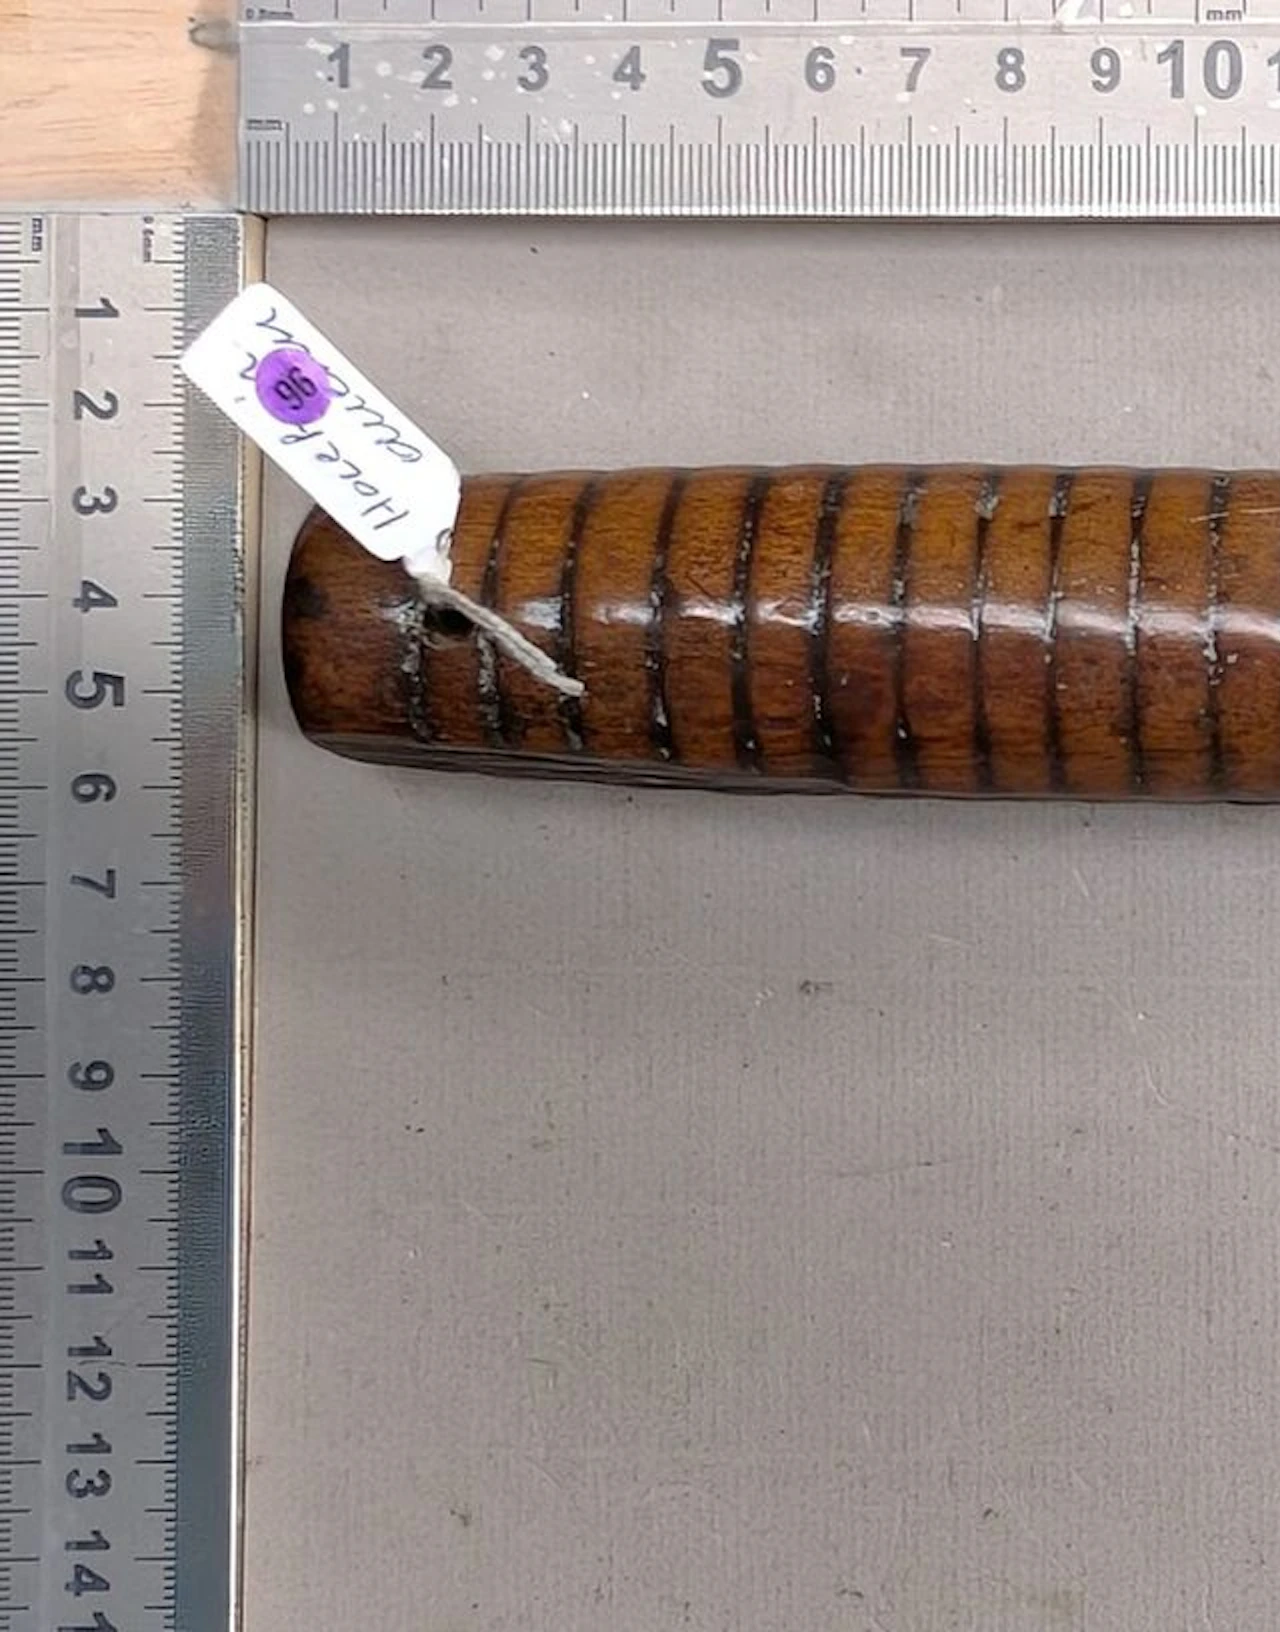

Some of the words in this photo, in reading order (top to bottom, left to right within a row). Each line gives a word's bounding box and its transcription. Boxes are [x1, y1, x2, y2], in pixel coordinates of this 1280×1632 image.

[1206, 9, 1242, 21] mm
[327, 43, 351, 89] 1
[421, 45, 453, 90] 2
[517, 45, 549, 92] 3
[612, 45, 646, 91] 4
[701, 38, 743, 98] 5
[804, 45, 836, 93] 6
[900, 47, 931, 93] 7
[994, 47, 1026, 93] 8
[1089, 46, 1121, 93] 9
[1156, 39, 1243, 100] 10
[75, 297, 119, 320] 1
[71, 389, 119, 421] 2
[71, 485, 119, 516] 3
[71, 580, 119, 614] 4
[64, 670, 126, 710] 5
[70, 773, 117, 804] 6
[70, 869, 116, 899] 7
[70, 965, 115, 995] 8
[67, 1060, 115, 1092] 9
[60, 1127, 123, 1214] 10
[67, 1239, 114, 1294] 11
[66, 1335, 112, 1402] 12
[65, 1432, 112, 1499] 13
[64, 1530, 111, 1597] 14
